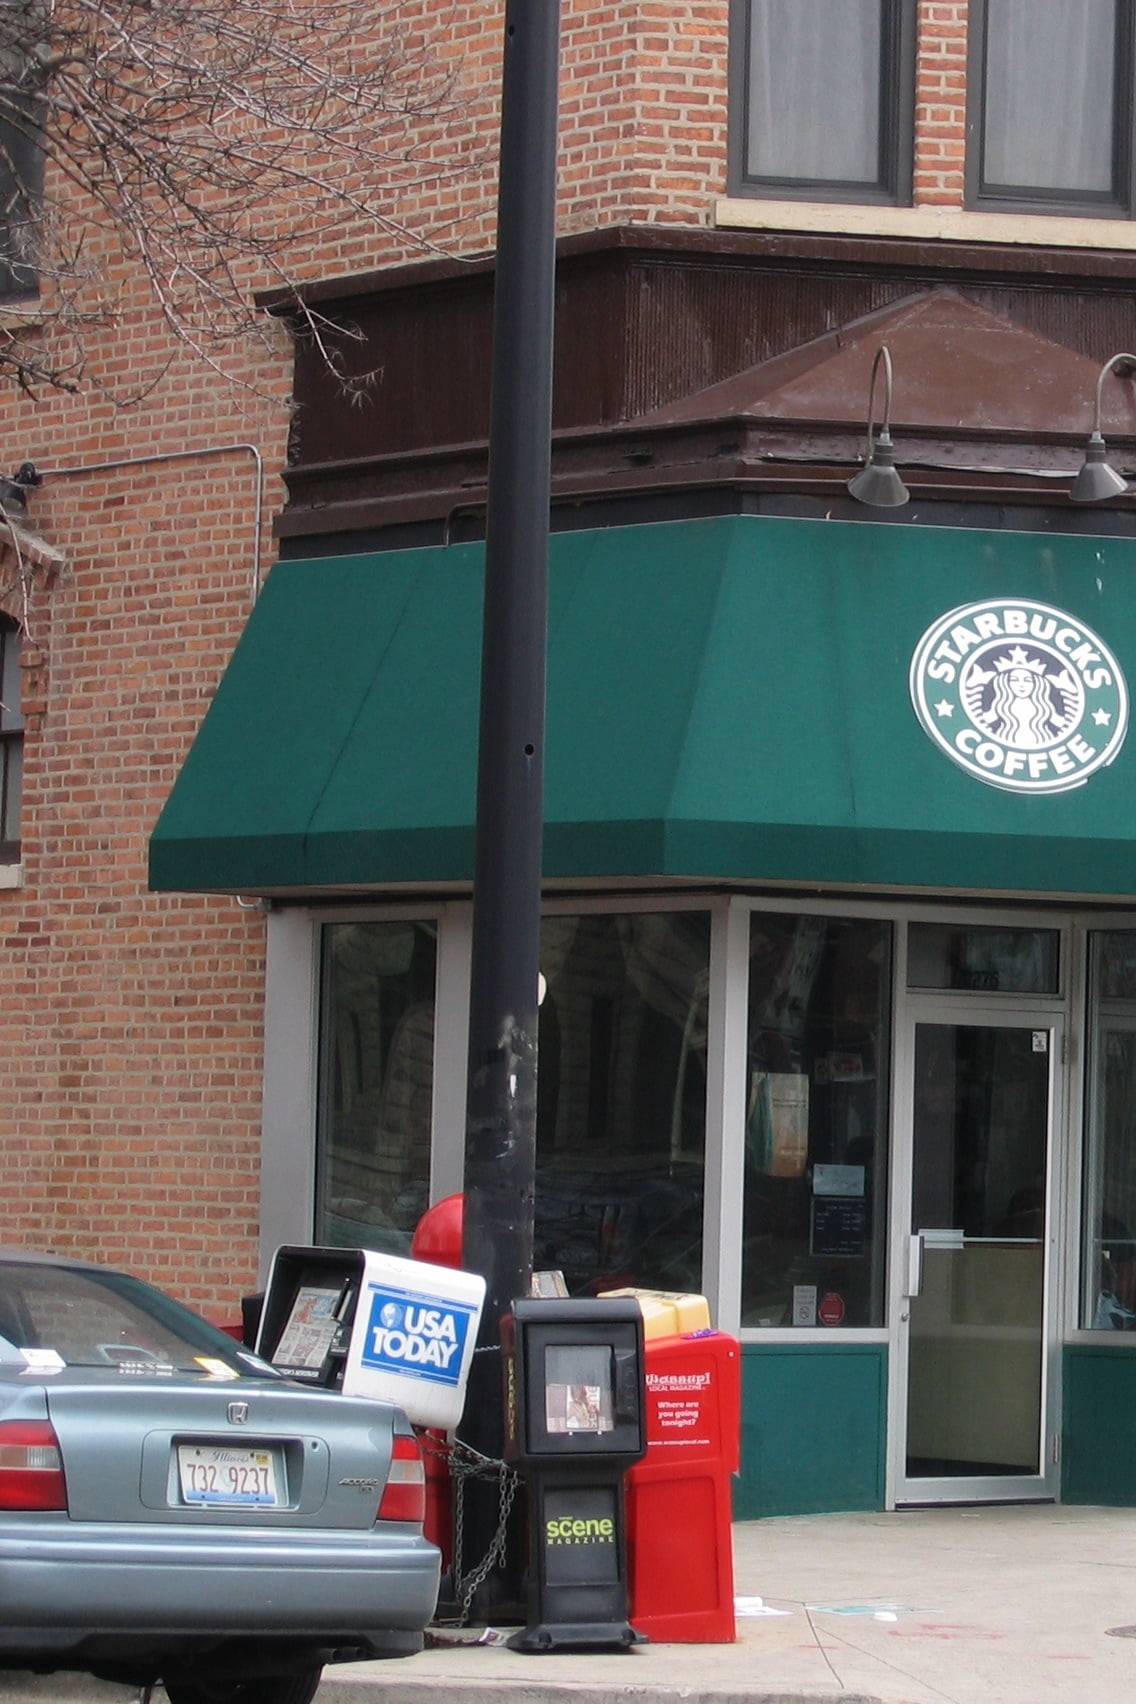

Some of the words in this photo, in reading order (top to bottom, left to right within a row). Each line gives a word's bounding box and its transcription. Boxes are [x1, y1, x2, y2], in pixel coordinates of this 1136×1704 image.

[927, 610, 1112, 689] STARBUCKS
[955, 729, 1097, 778] COFFEE
[404, 1305, 458, 1343] USA
[372, 1326, 459, 1370] TODAY
[657, 1401, 685, 1409] Where
[657, 1411, 674, 1420] you
[674, 1410, 699, 1419] going
[212, 1450, 250, 1463] Illinois
[186, 1463, 220, 1494] 732
[228, 1466, 270, 1495] 9237
[545, 1518, 614, 1538] scene
[546, 1536, 615, 1545] MAGAZINE
